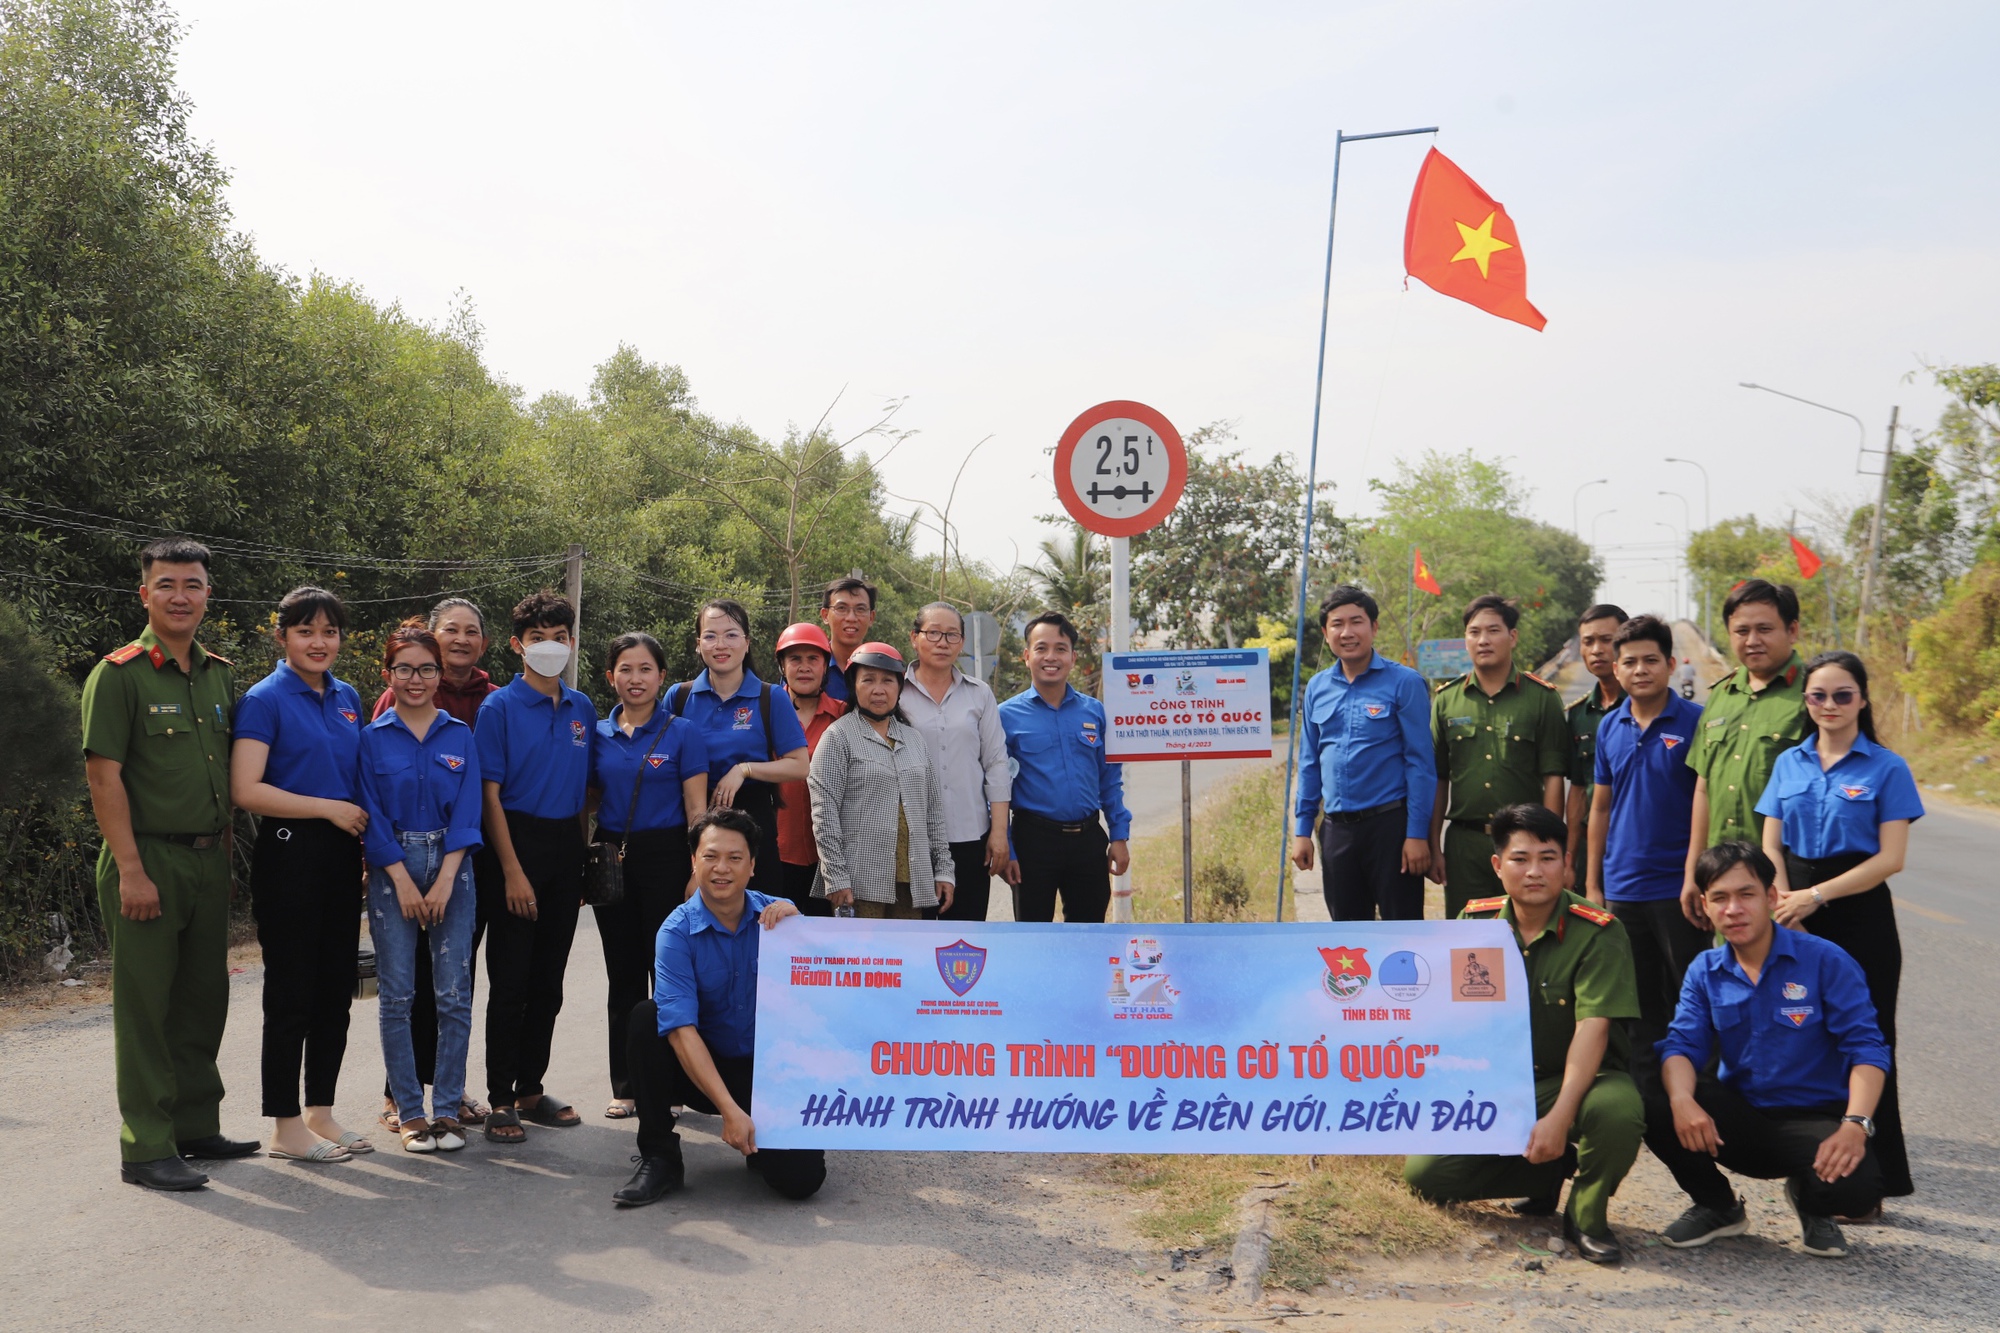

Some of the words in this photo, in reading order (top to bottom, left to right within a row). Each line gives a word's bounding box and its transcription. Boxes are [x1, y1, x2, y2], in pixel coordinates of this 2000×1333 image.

[1096, 435, 1140, 478] 2,5
[1146, 435, 1153, 456] t
[1150, 699, 1187, 710] CÔNG
[1191, 698, 1225, 709] TRÌNH
[1114, 713, 1168, 726] ĐƯỜNG
[1173, 710, 1192, 724] CỜ
[1197, 709, 1215, 723] TỔ
[1221, 708, 1262, 722] QUỐC
[1173, 727, 1193, 737] HUYỆN
[1250, 726, 1260, 734] TRE
[1165, 741, 1186, 749] Tháng
[886, 958, 902, 966] MINH
[835, 971, 862, 987] LAO
[864, 971, 901, 988] ĐỘNG
[1369, 1006, 1389, 1020] BẾN
[1392, 1009, 1411, 1020] TRE
[870, 1040, 995, 1077] CHƯƠNG
[1006, 1039, 1096, 1077] TRÌNH
[1237, 1040, 1280, 1079] CỜ
[1288, 1034, 1329, 1079] TỔ
[800, 1088, 895, 1128] HÀNH
[904, 1091, 999, 1130] TRÌNH
[1006, 1092, 1119, 1131] HƯỚNG
[1127, 1087, 1168, 1132] VỀ
[1171, 1093, 1253, 1132] BIÊN
[1339, 1088, 1421, 1132] BIỂN
[1431, 1090, 1498, 1132] ĐẢO
